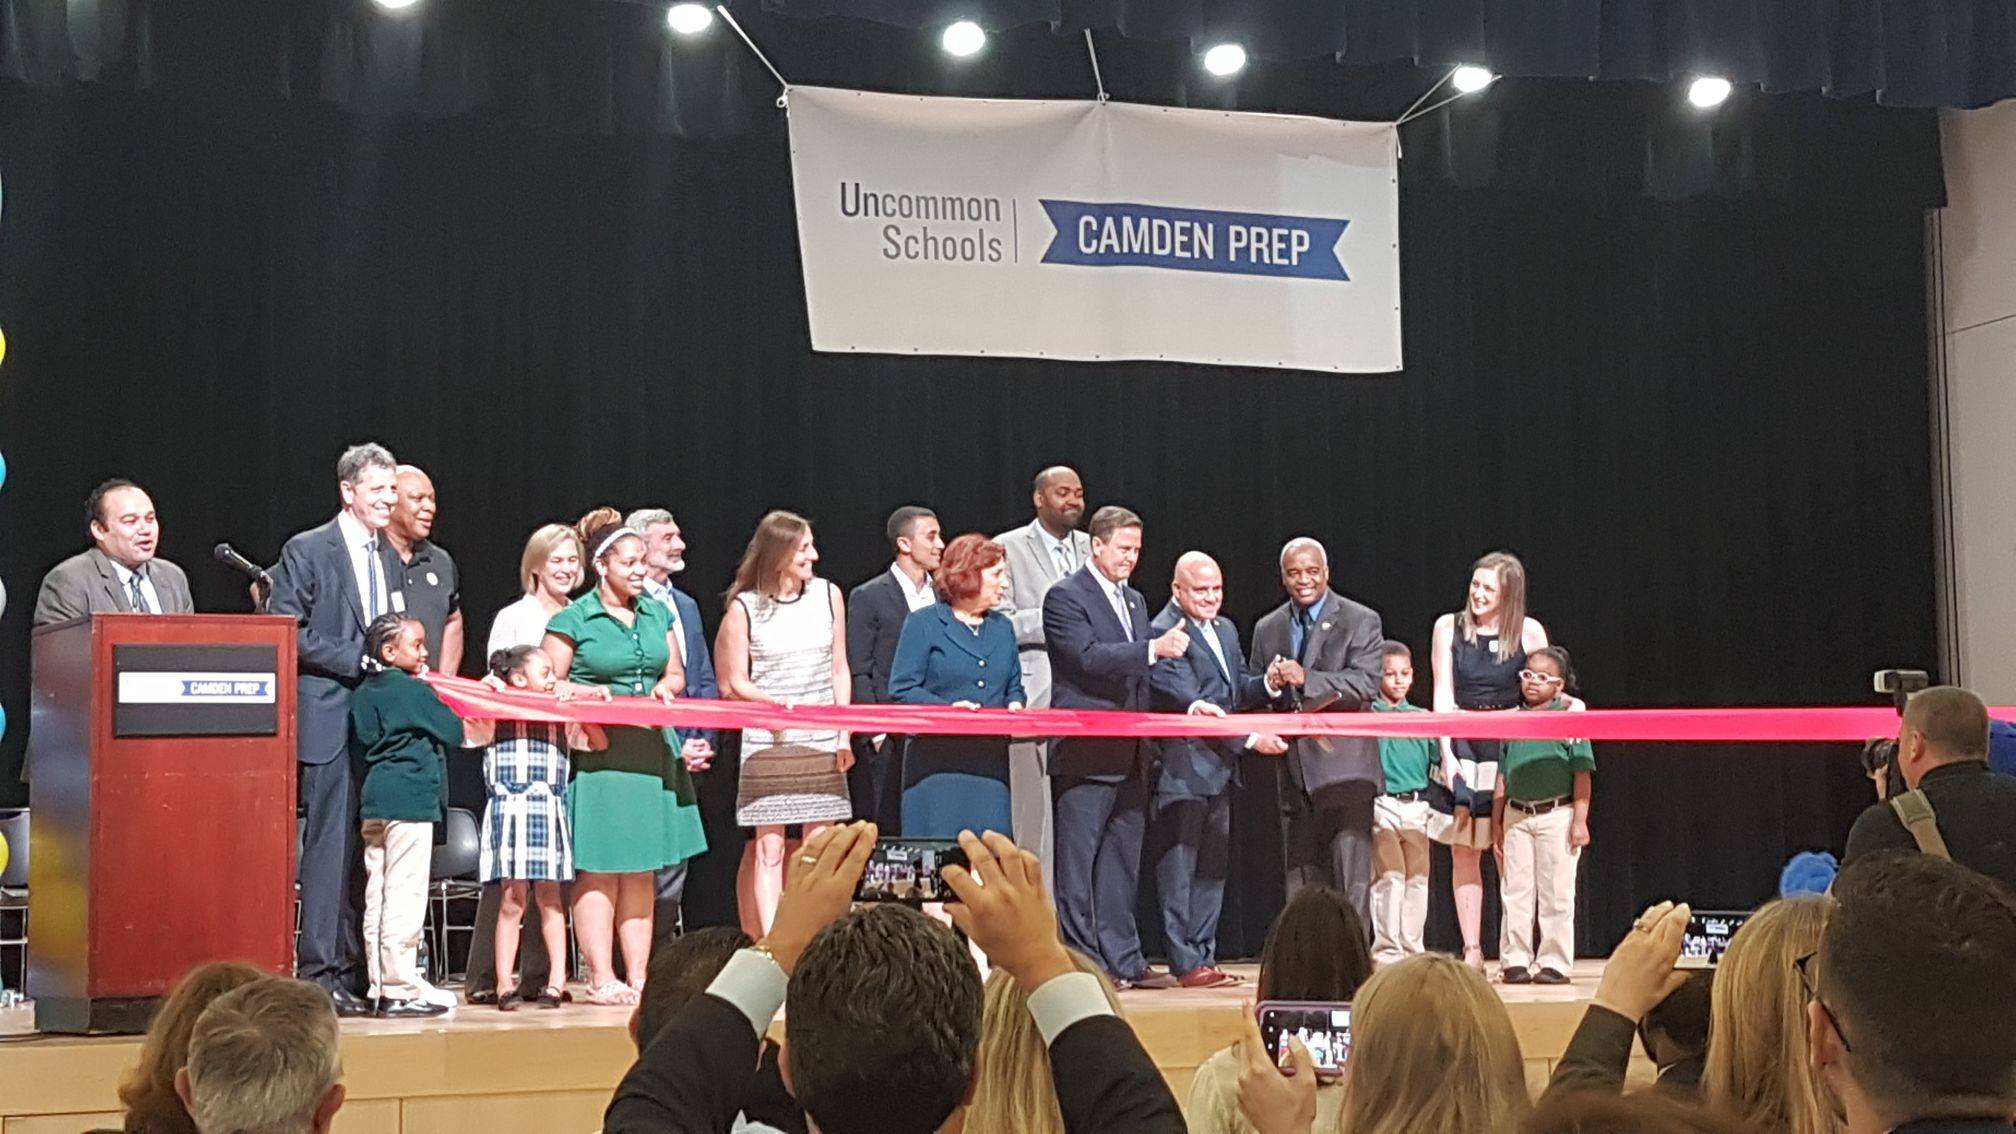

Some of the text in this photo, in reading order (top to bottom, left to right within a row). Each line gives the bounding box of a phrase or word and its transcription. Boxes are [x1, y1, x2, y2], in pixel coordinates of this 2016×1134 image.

[840, 181, 1001, 222] Uncommon
[882, 223, 1002, 263] Schools
[1077, 214, 1311, 266] CAMDEN PREP
[190, 682, 260, 695] CAMDEN PREP
